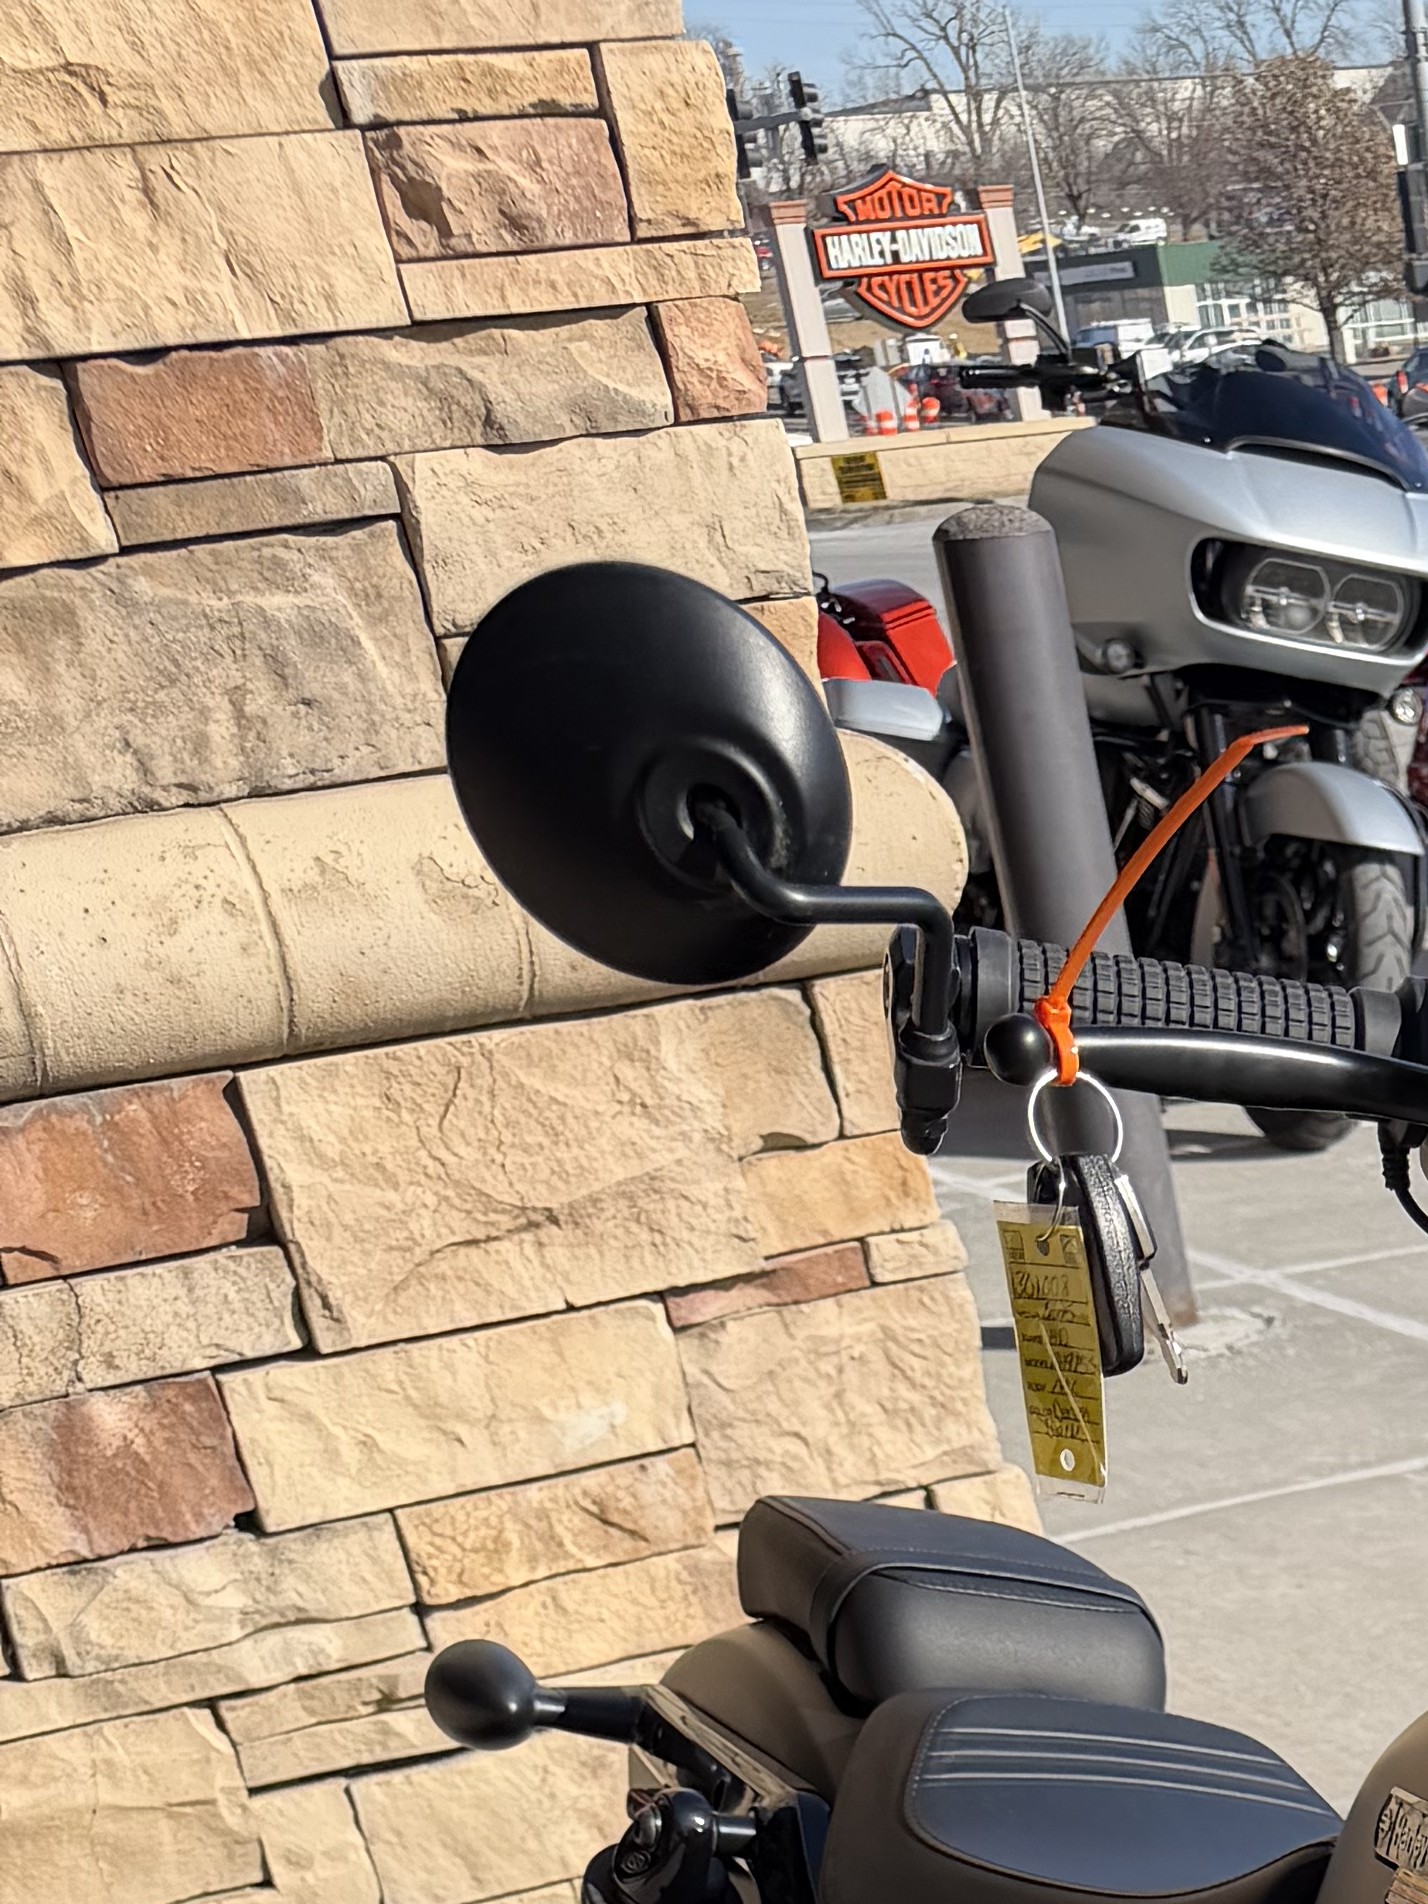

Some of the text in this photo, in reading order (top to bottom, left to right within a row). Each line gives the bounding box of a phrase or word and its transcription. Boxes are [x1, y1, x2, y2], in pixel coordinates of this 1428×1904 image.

[853, 182, 939, 221] MOTOR
[825, 223, 984, 269] HARLEY-DAVIDSON
[870, 269, 956, 317] CYCLES
